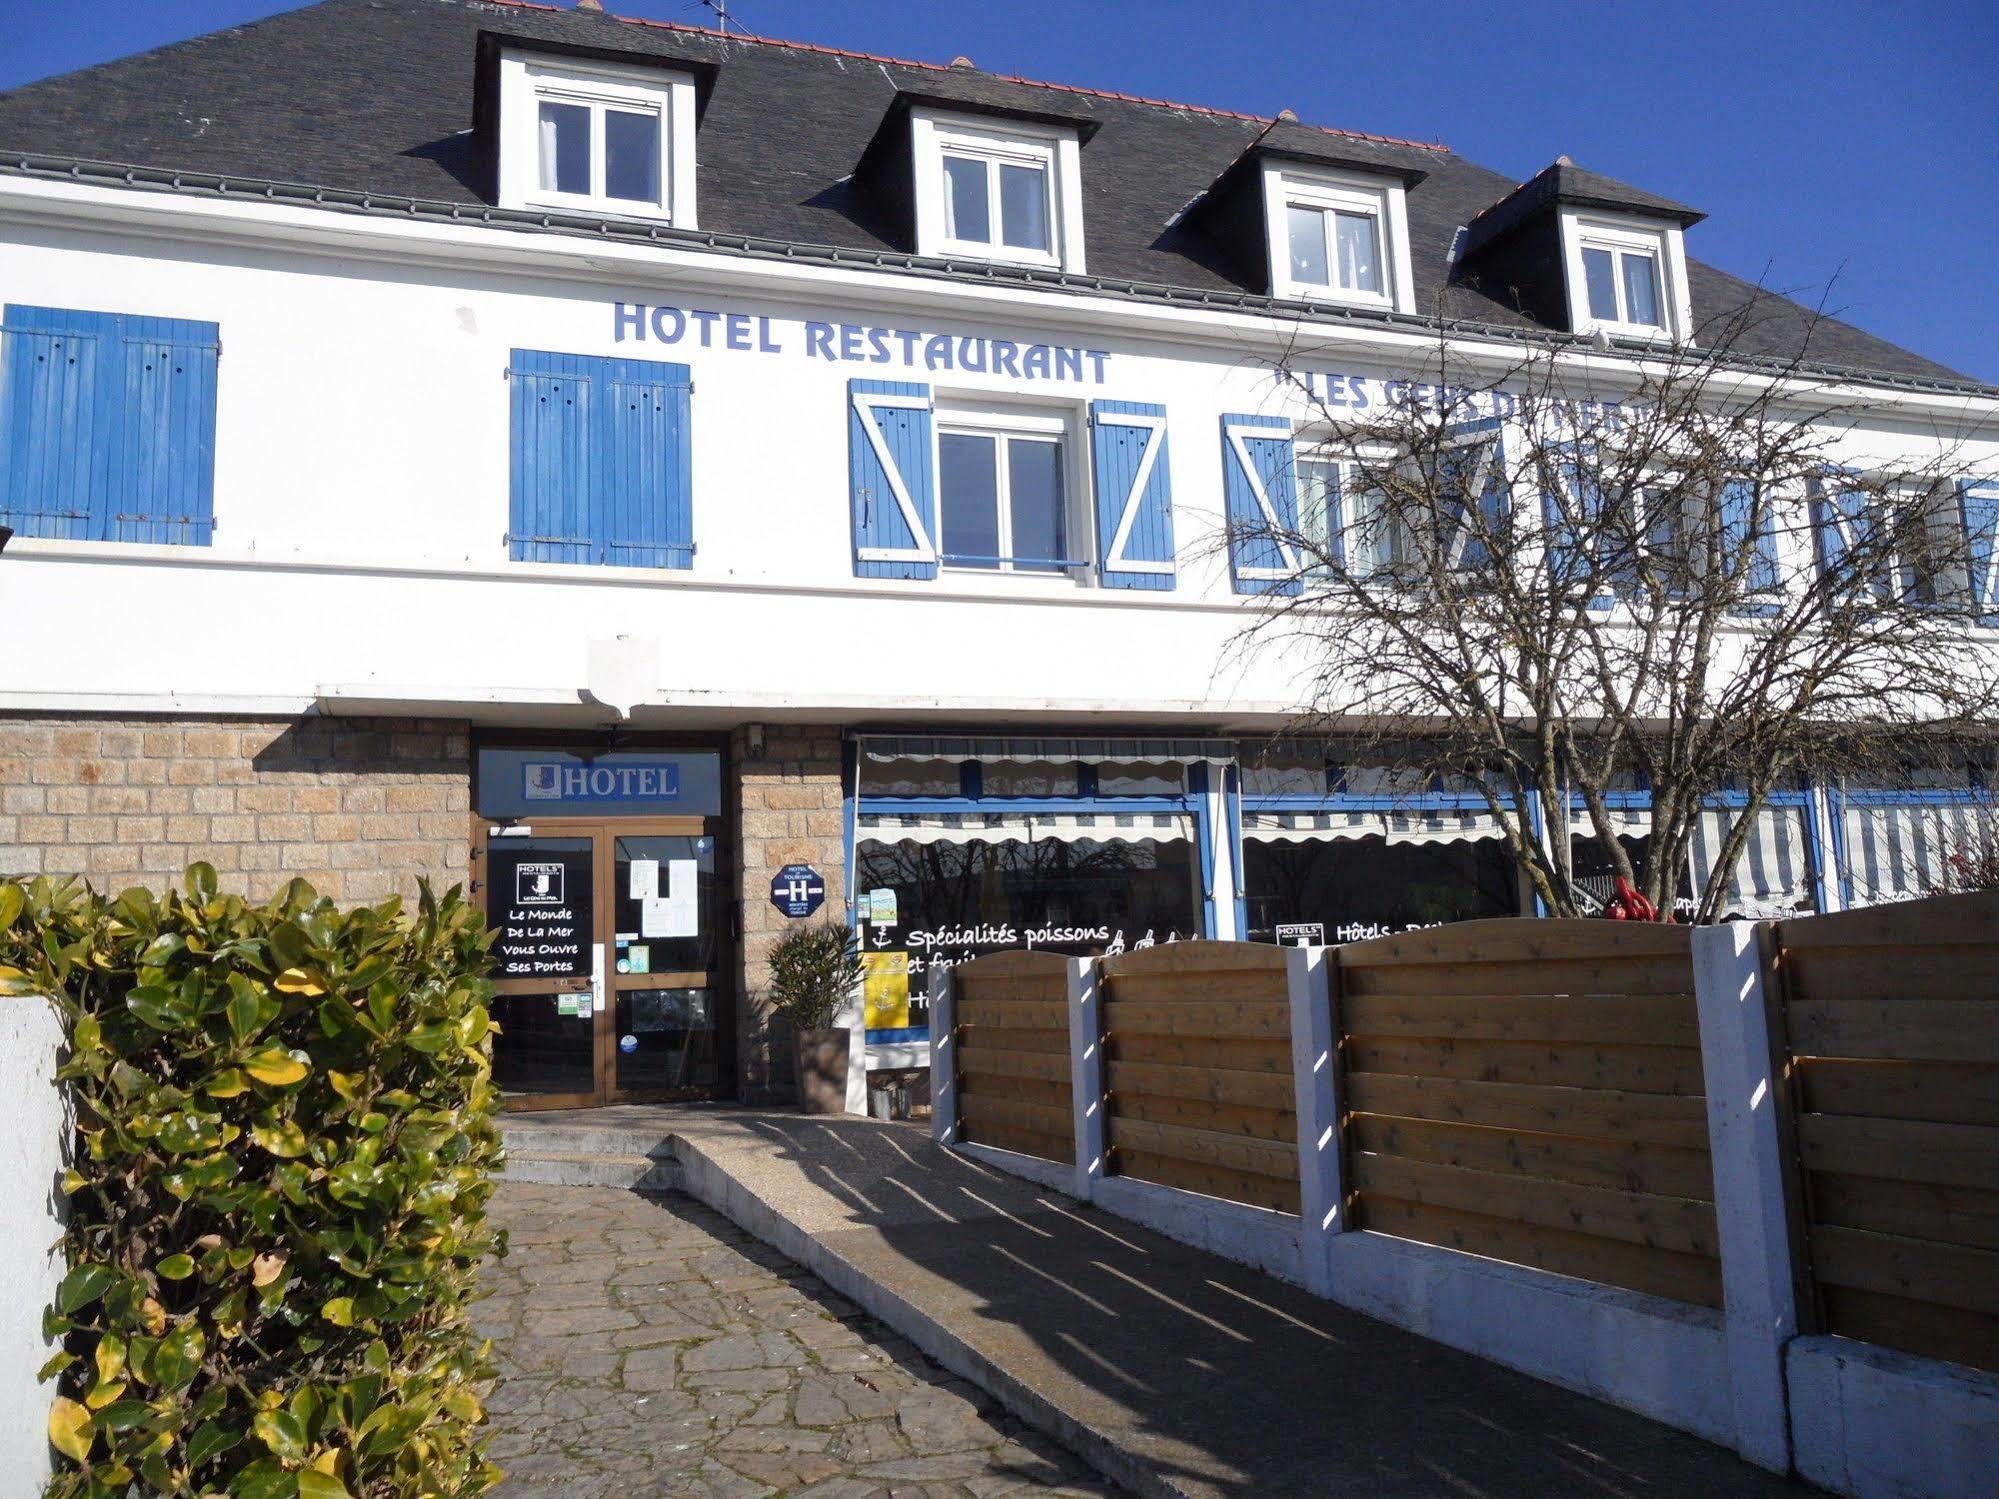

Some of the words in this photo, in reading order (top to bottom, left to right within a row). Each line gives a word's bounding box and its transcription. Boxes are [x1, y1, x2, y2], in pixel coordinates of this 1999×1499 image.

[613, 301, 782, 354] HOTEL
[804, 320, 1112, 384] RESTAURANT
[564, 767, 678, 796] HOTEL
[789, 880, 809, 902] H
[509, 910, 525, 921] Le
[528, 908, 573, 920] Monde
[507, 927, 524, 938] De
[528, 927, 544, 938] La
[548, 926, 574, 938] Mer
[905, 923, 1018, 954] Spécialités
[1024, 921, 1110, 950] poissons
[1336, 921, 1391, 942] Hôtels
[502, 944, 536, 956] Vous
[538, 944, 579, 955] Ouvre
[506, 962, 532, 973] Ses
[534, 960, 574, 973] Portes
[907, 955, 925, 975] et
